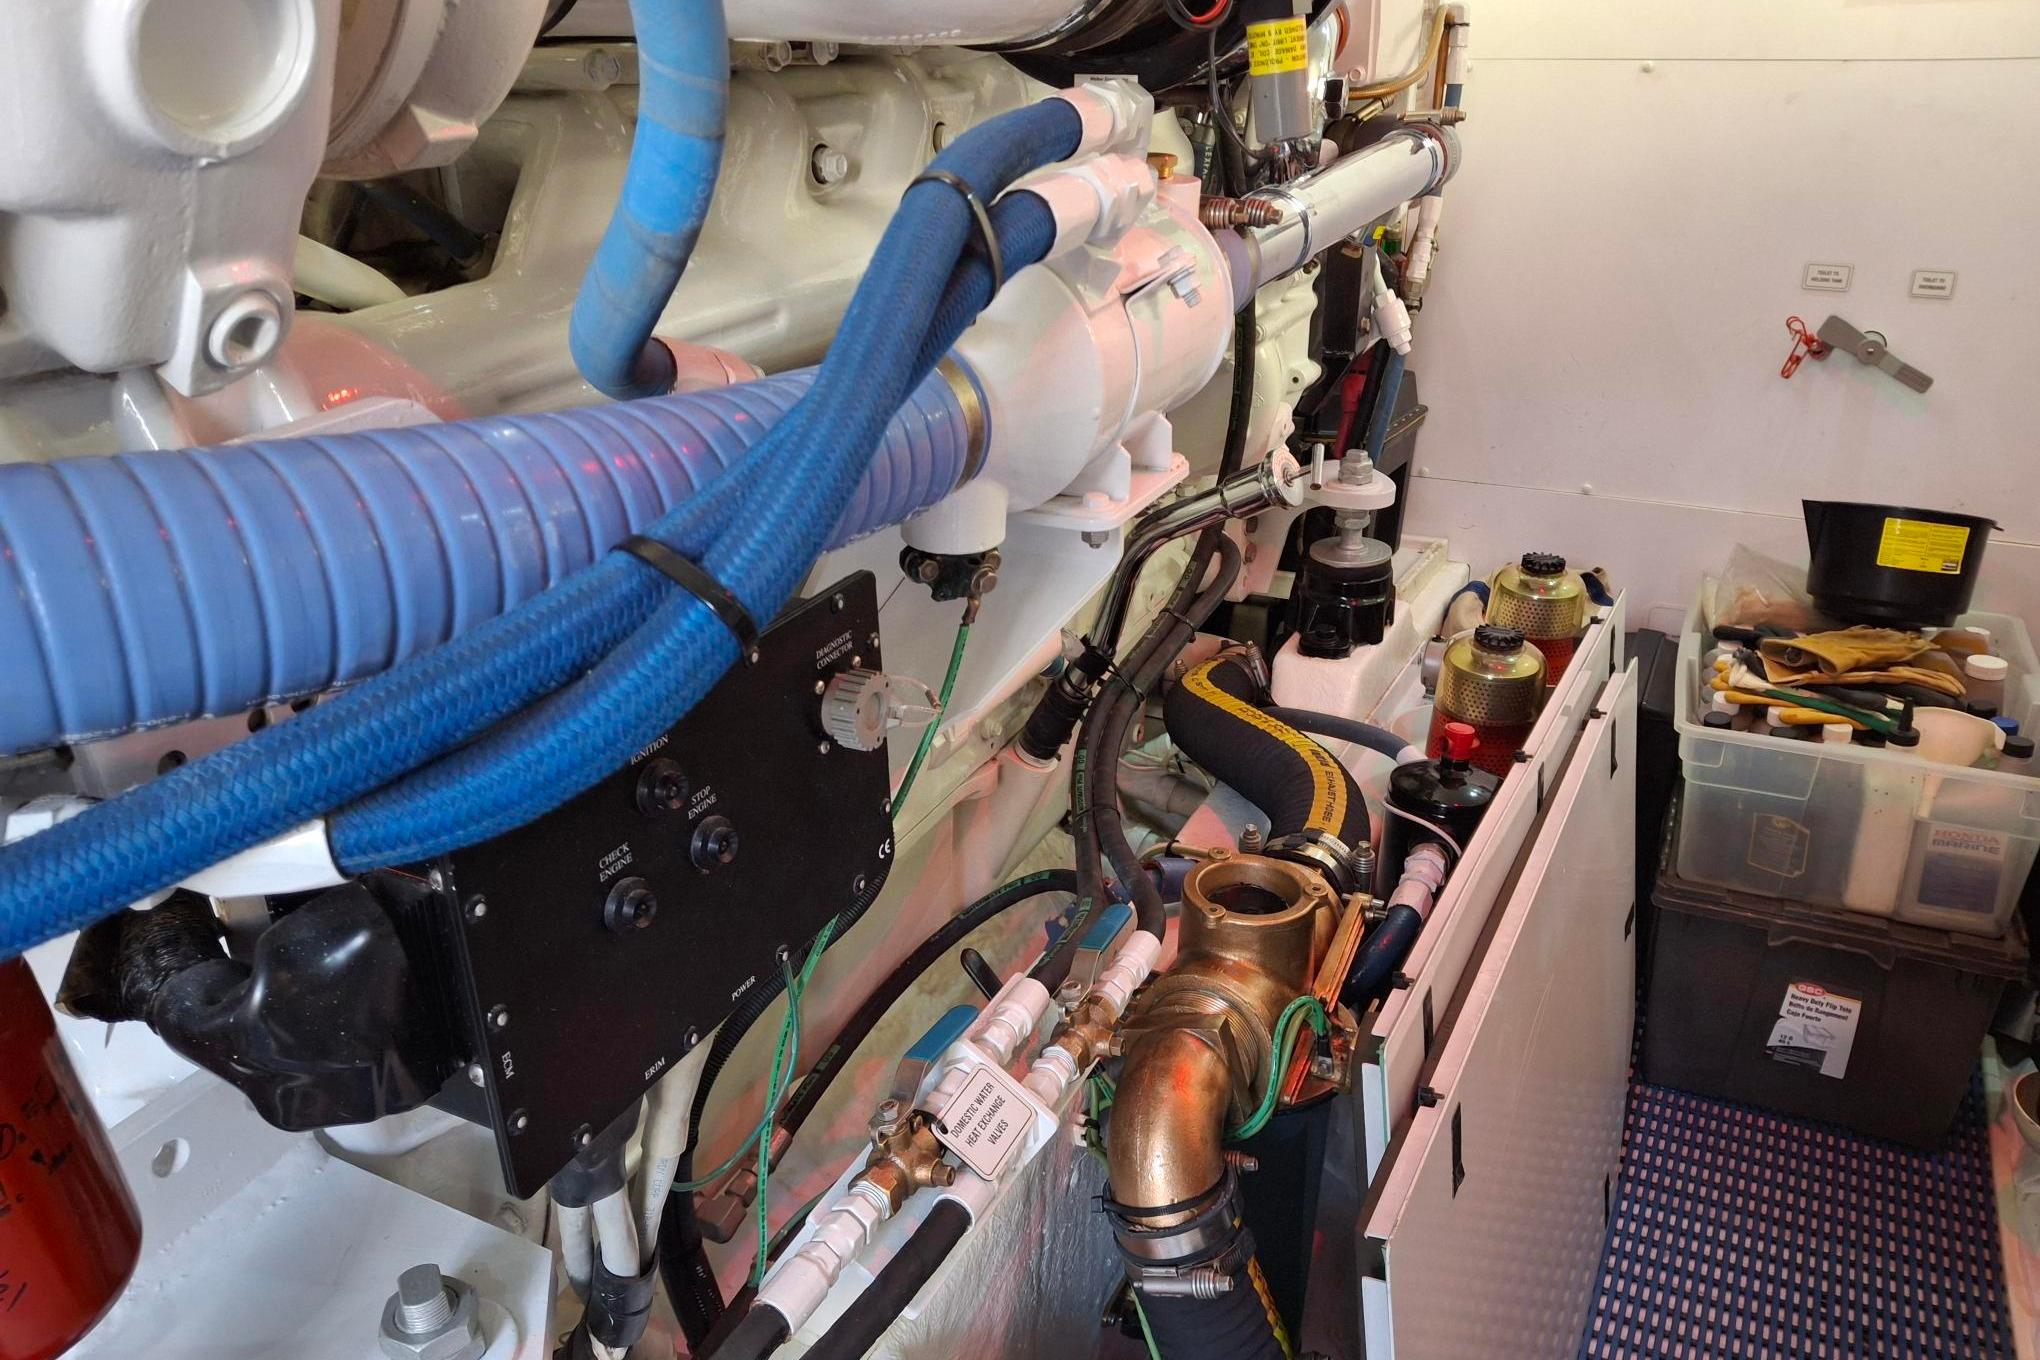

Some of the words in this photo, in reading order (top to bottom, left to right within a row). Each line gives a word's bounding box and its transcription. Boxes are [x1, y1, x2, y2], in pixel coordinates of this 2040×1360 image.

[815, 630, 852, 660] DIAGNOSTIC
[816, 641, 854, 670] CONNECTOR
[631, 735, 669, 765] IGNITION
[687, 793, 717, 820] ENGINE
[691, 785, 711, 805] STOP
[599, 841, 630, 870] CHECK
[600, 852, 633, 883] ENGINE
[730, 975, 757, 1001] POWER
[1790, 993, 1809, 1003] Heavy
[1810, 998, 1824, 1007] Duty
[1825, 1002, 1837, 1010] Flip
[501, 1051, 515, 1080] ECM
[644, 1057, 666, 1081] ERIM
[950, 1103, 979, 1139] DOMESTIC
[974, 1082, 995, 1107] WATER
[965, 1126, 981, 1147] HEAT
[978, 1095, 1006, 1131] EXCHANGE
[987, 1119, 1009, 1145] VALVES
